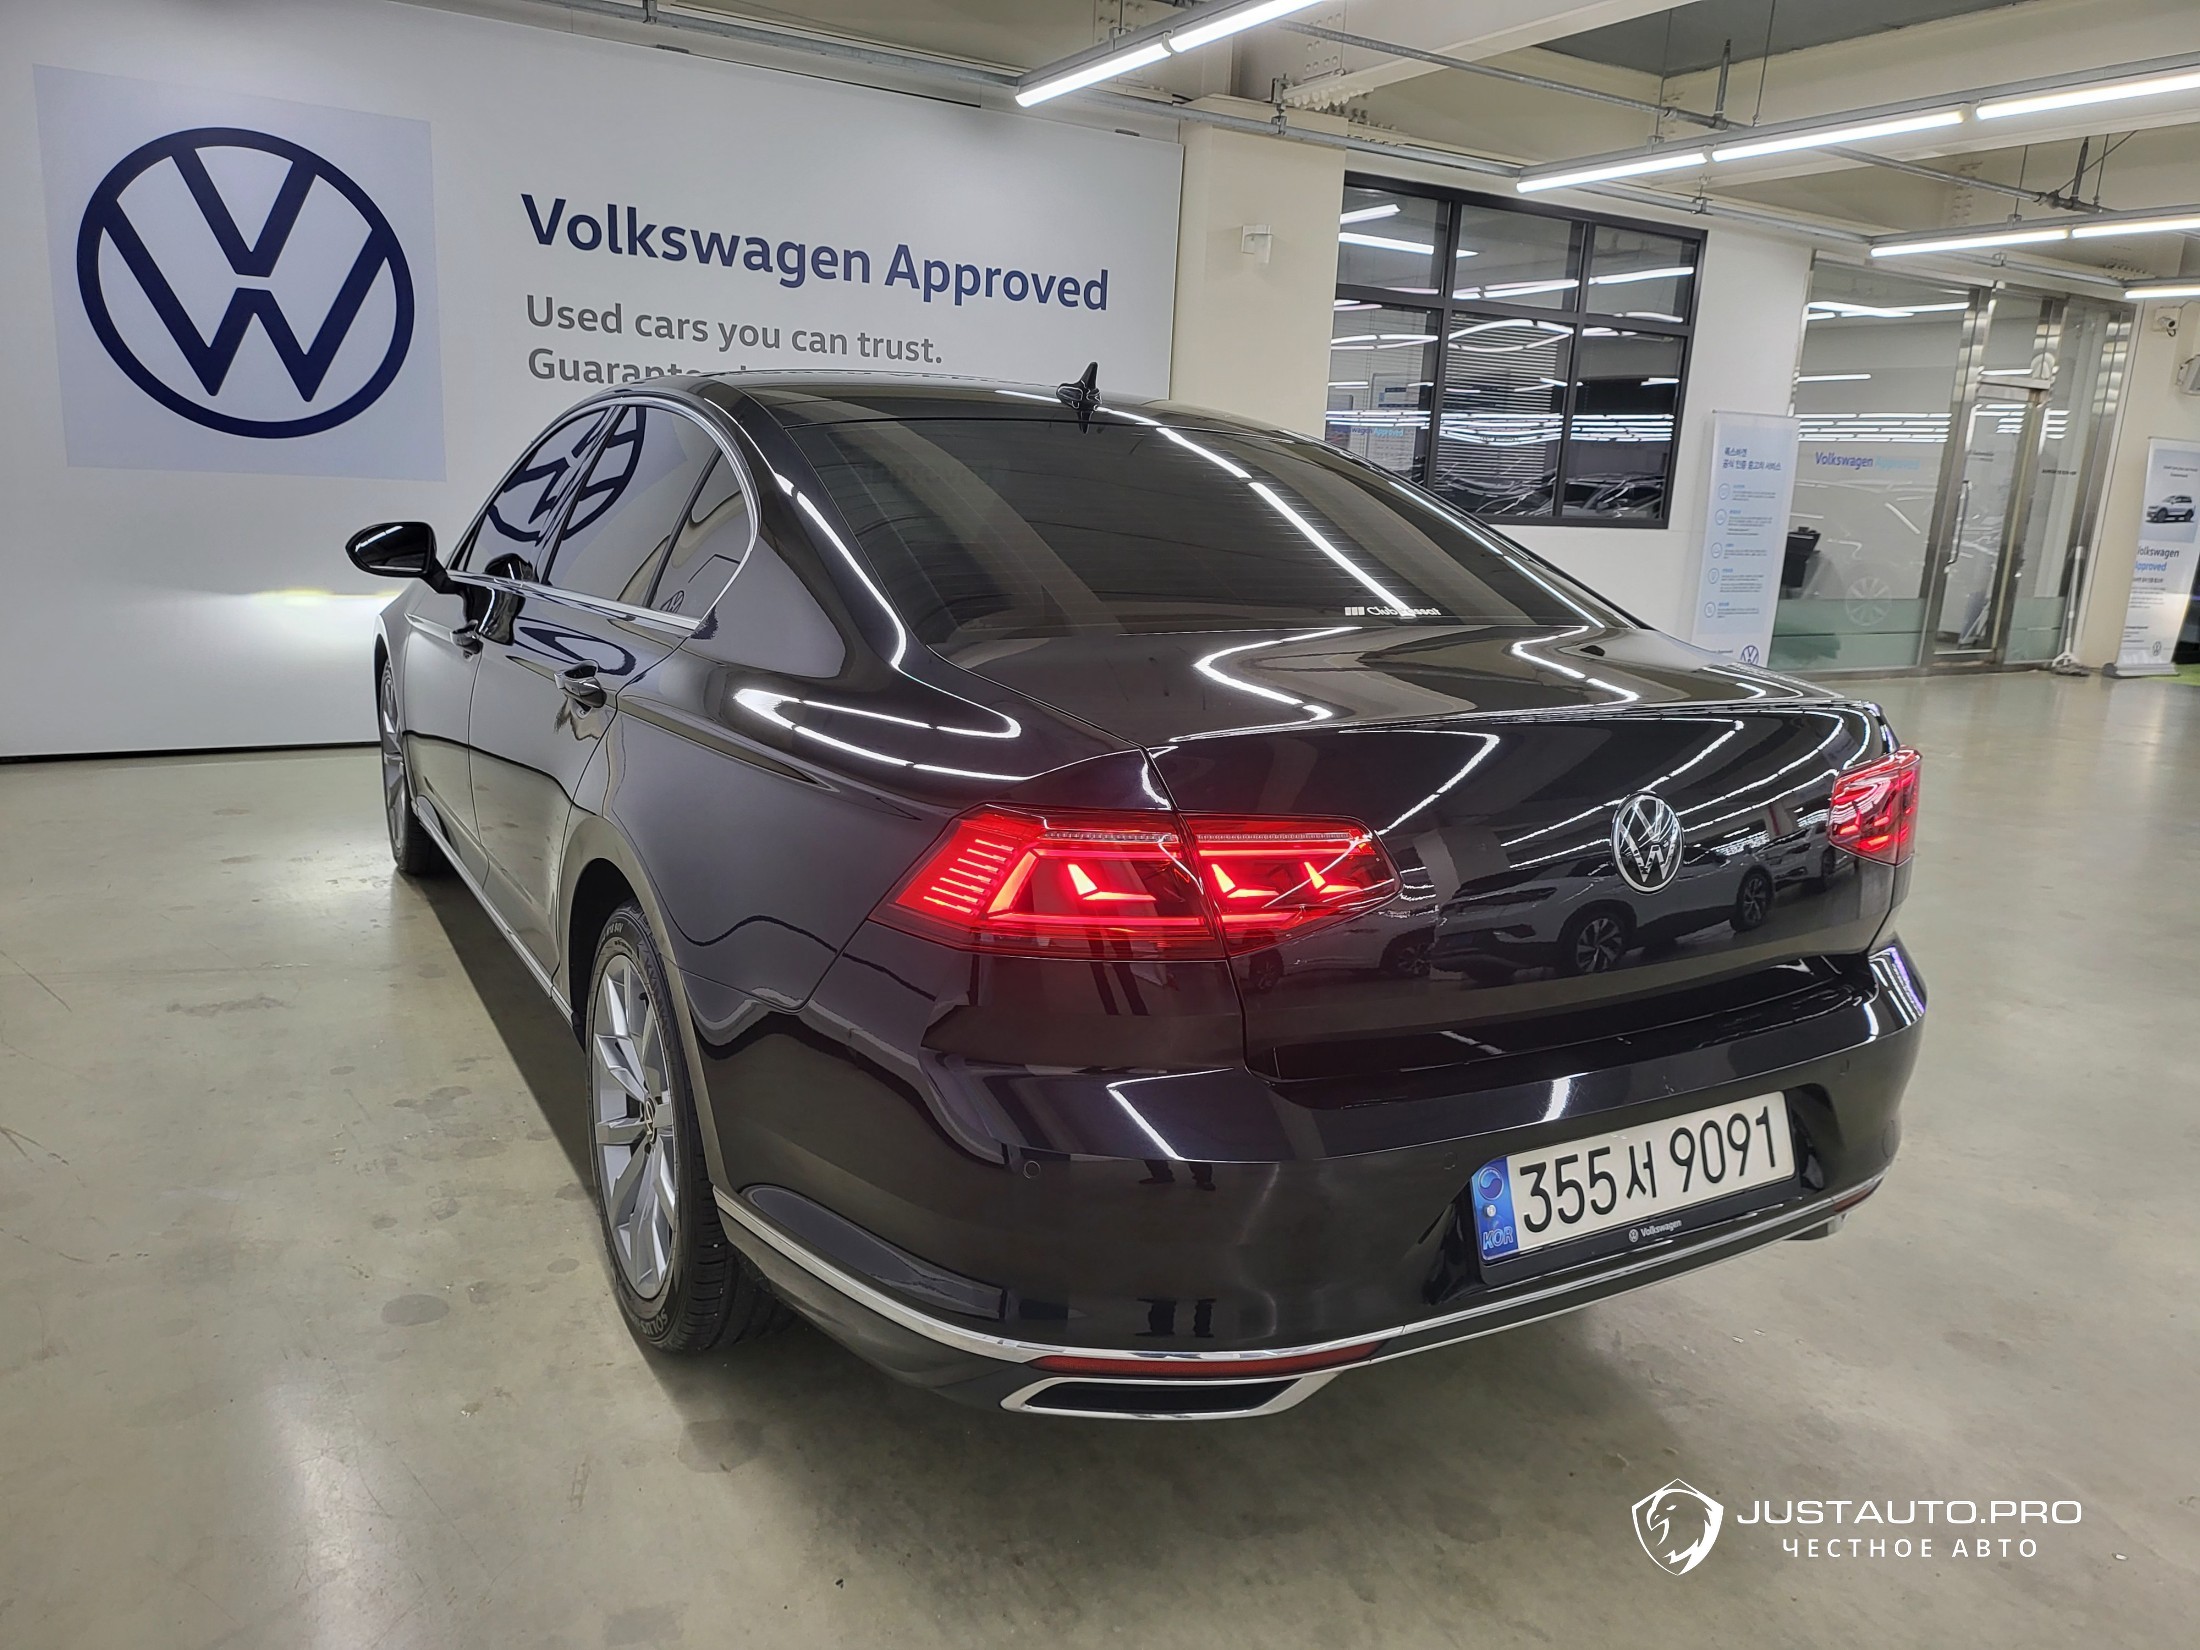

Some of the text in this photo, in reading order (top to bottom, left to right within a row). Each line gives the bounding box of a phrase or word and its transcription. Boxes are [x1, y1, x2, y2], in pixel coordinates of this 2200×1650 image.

[521, 193, 1109, 311] Volkswagen Approved
[526, 294, 943, 364] Used cars you can trust.
[1815, 451, 1874, 470] Volkswagen
[1519, 1106, 1777, 1234] 355서 9091
[1482, 1225, 1514, 1250] KOR
[1640, 1219, 1682, 1237] Volkswagen
